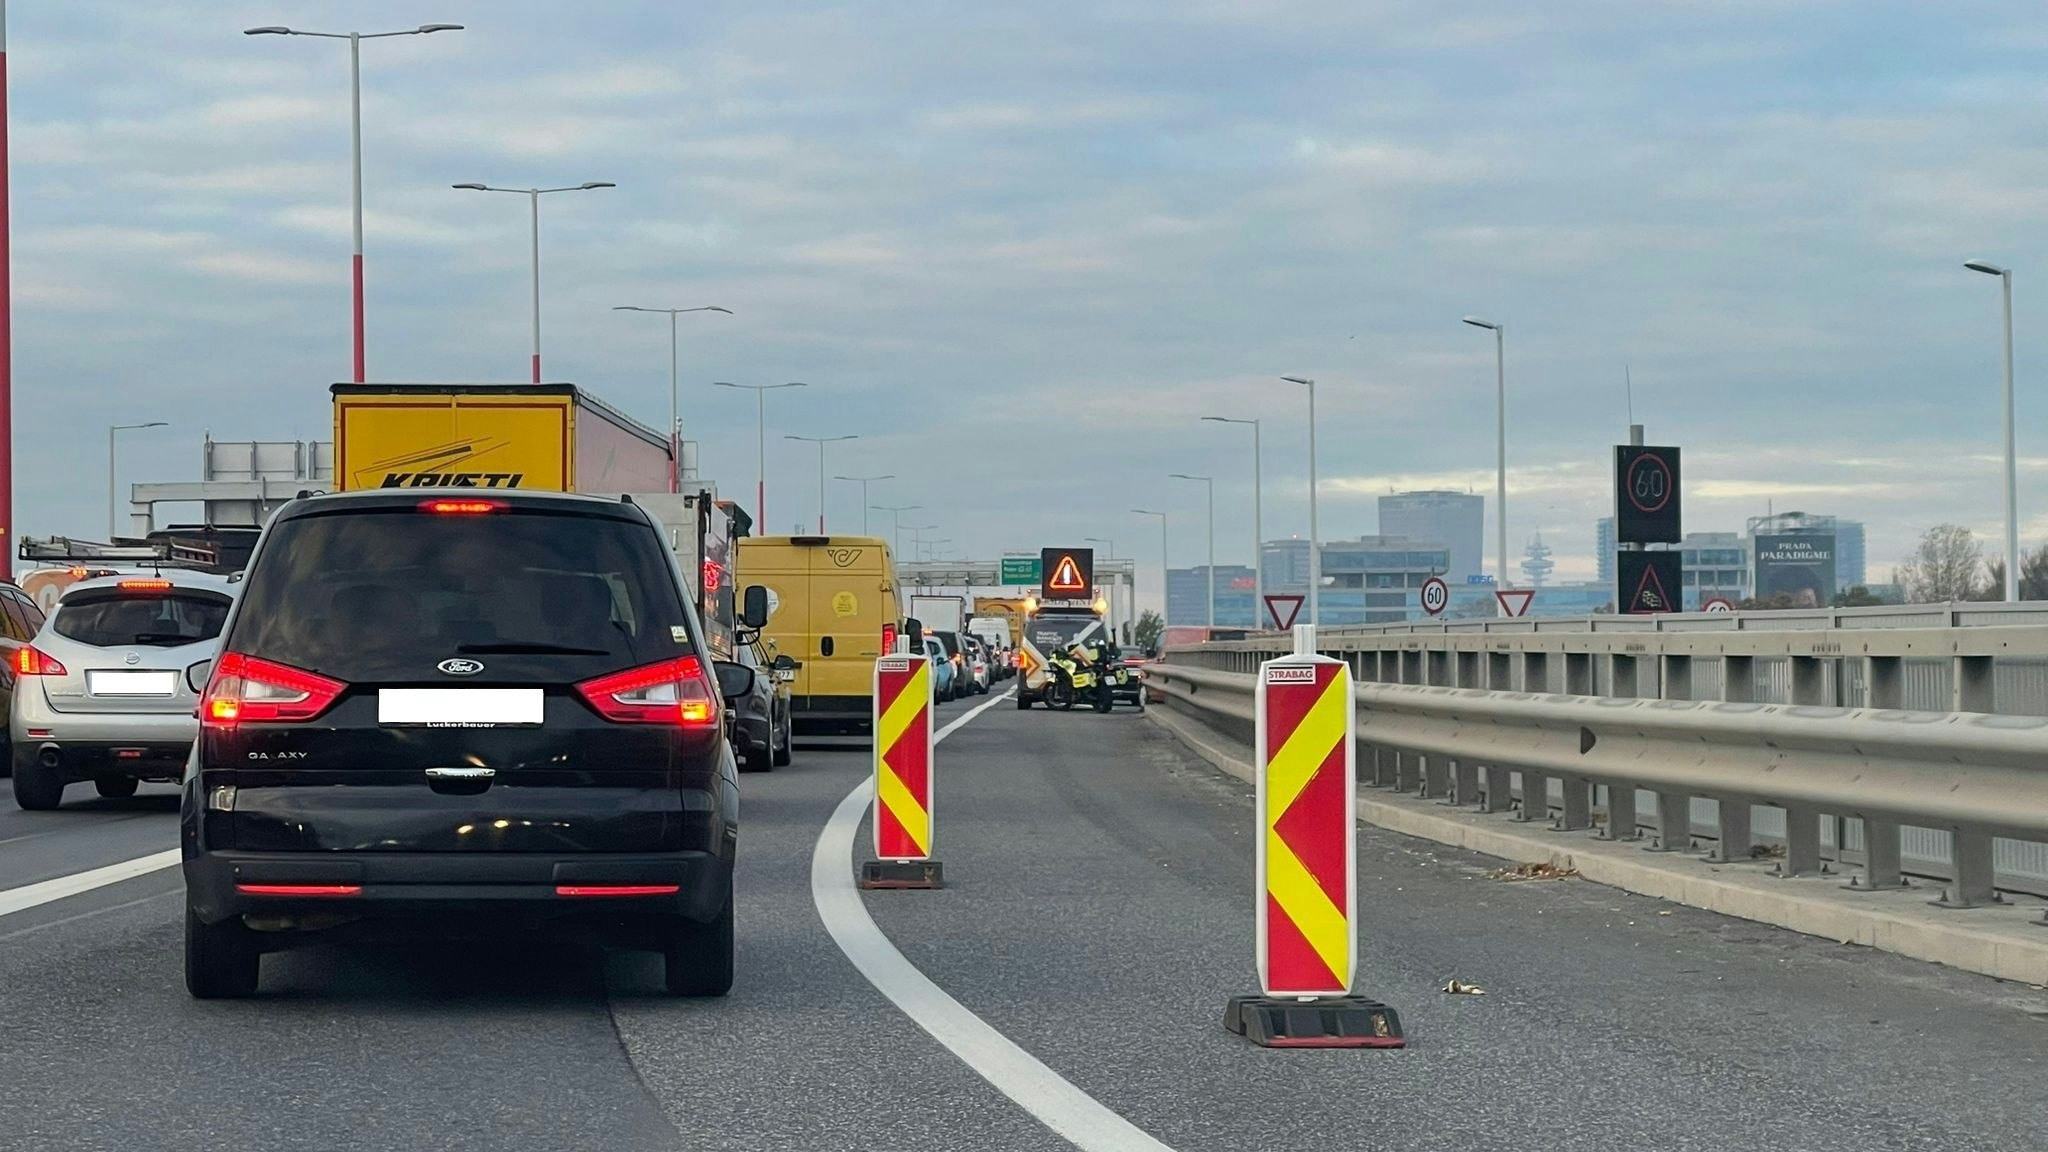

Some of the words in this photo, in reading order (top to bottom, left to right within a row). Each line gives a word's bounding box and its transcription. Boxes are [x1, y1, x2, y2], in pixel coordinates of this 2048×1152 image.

[1636, 470, 1664, 497] 60
[1427, 587, 1441, 604] 60
[448, 661, 474, 673] Ford
[1268, 670, 1313, 679] STRABAG
[248, 752, 308, 760] GAAXY
